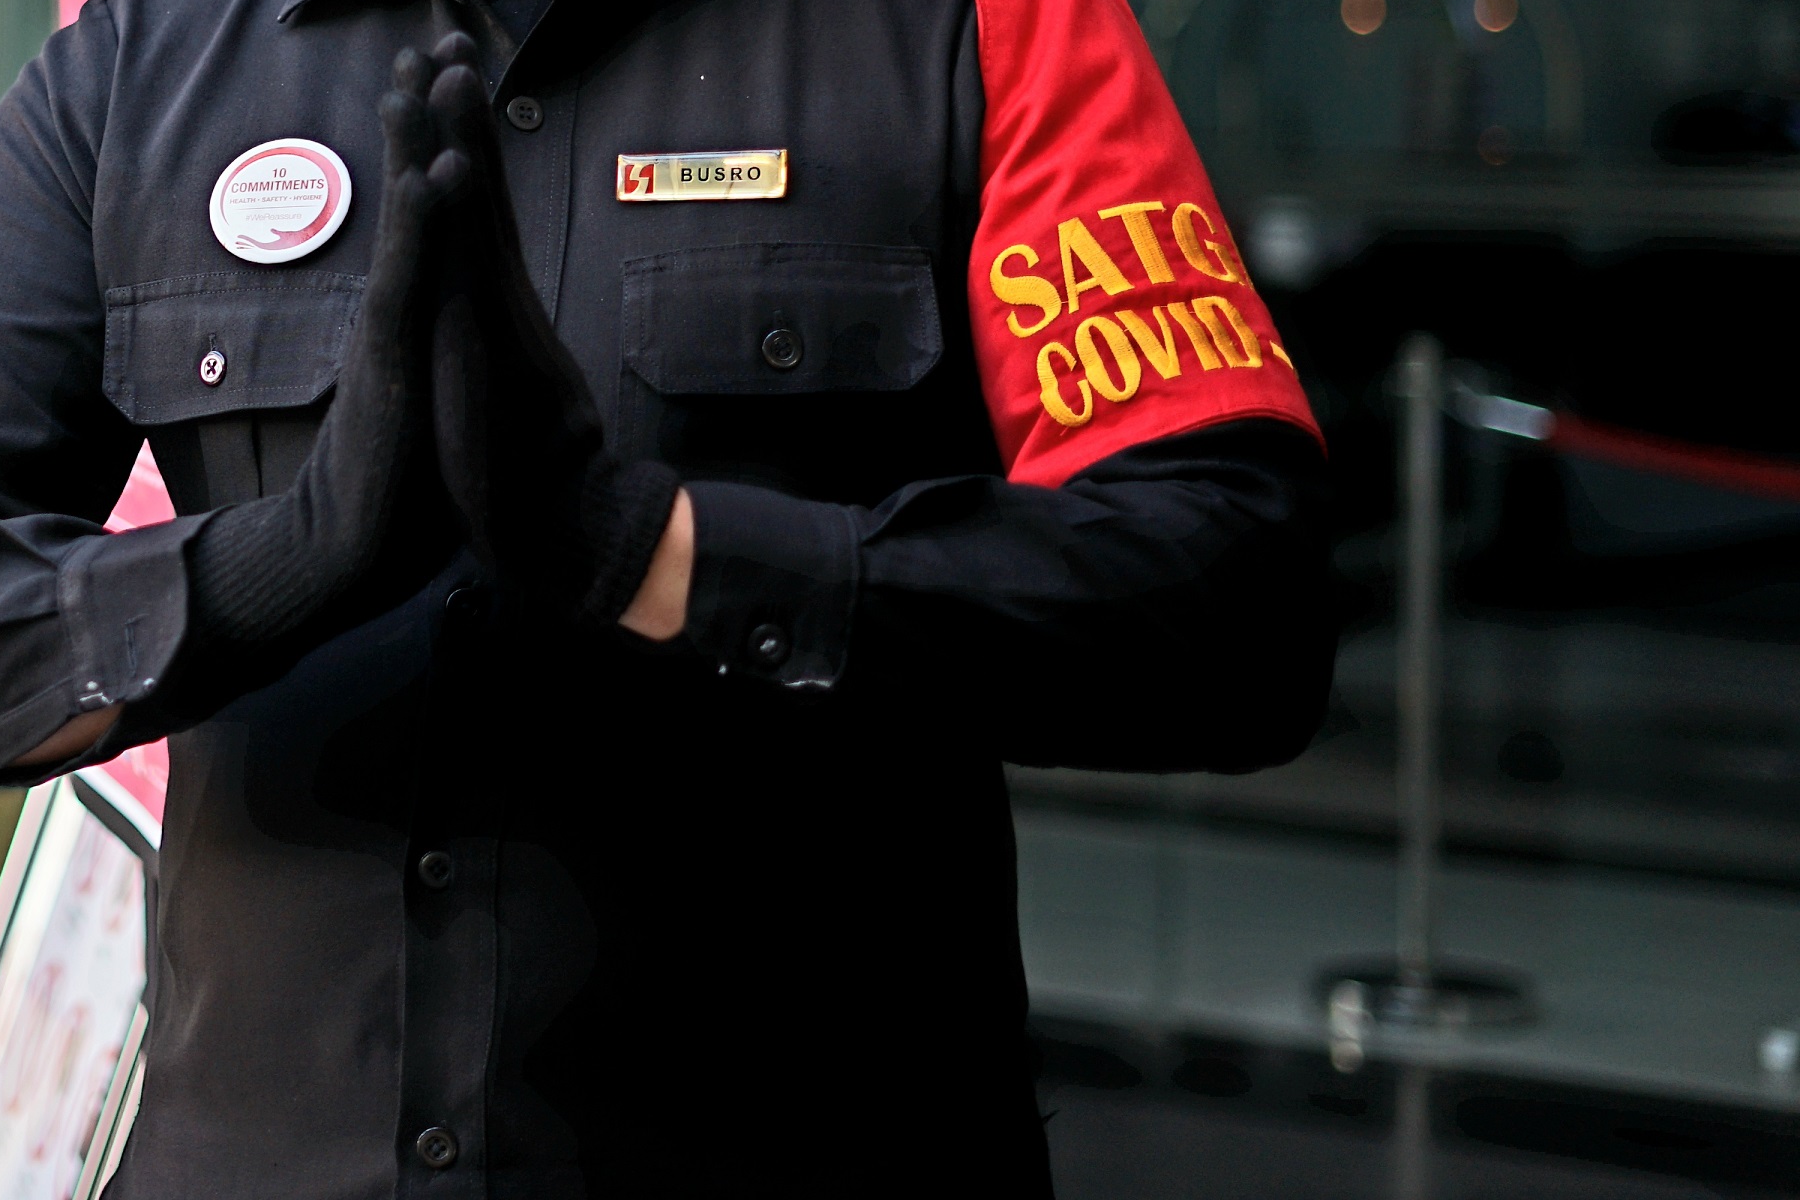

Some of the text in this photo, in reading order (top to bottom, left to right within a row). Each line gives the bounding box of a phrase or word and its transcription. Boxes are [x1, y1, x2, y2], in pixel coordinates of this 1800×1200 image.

[272, 167, 287, 179] 10
[680, 166, 761, 182] BUSRO
[231, 178, 325, 194] COMMITMENTS
[229, 197, 256, 205] HEALTH
[261, 195, 288, 203] SAFETY
[989, 200, 1253, 339] SATG
[1036, 295, 1296, 428] COVID-
